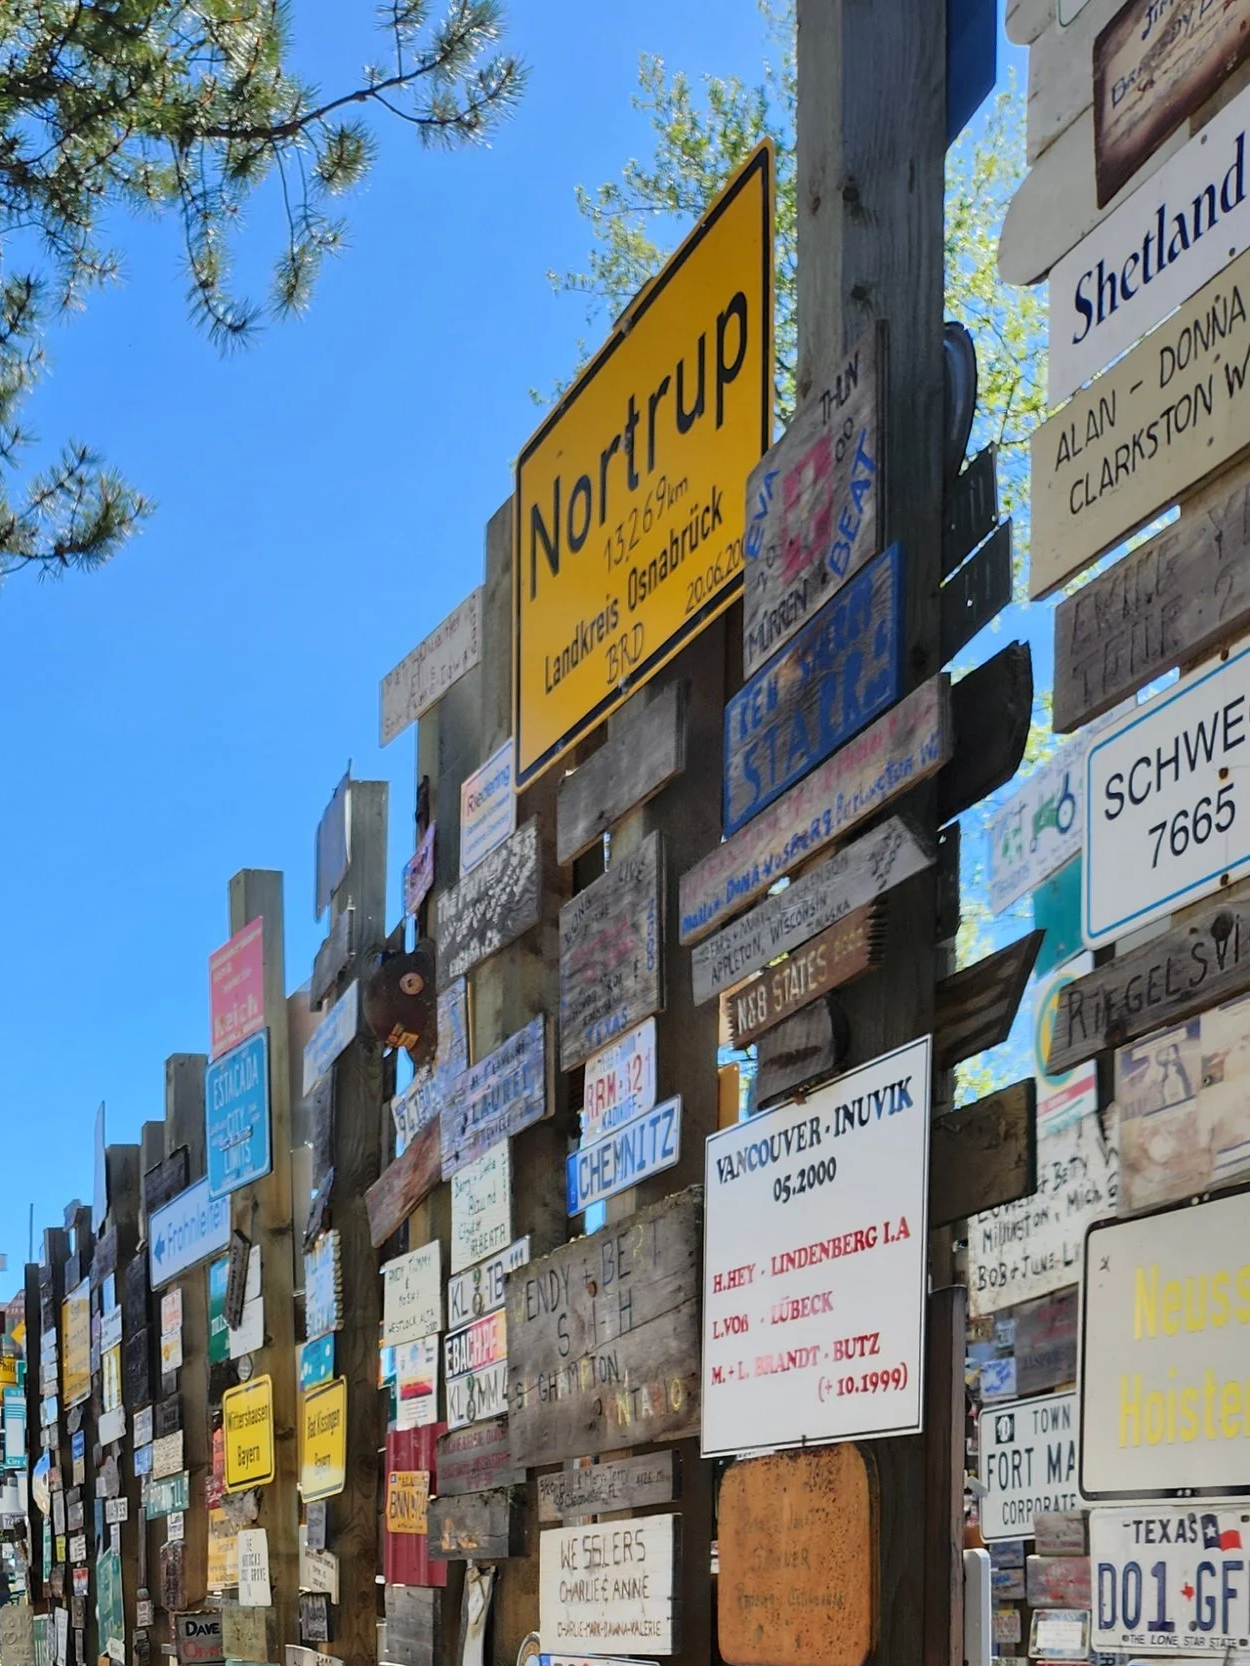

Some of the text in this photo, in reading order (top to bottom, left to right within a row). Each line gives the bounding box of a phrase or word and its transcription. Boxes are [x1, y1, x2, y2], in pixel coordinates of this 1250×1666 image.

[1070, 130, 1246, 345] Shetland
[1053, 285, 1246, 472] ALAN DONNA
[529, 290, 750, 602] Nortrup
[1067, 372, 1214, 516] CLARKSTON
[745, 427, 878, 578] EVA BEAT
[544, 484, 724, 696] Landkreis Osnabrück
[605, 620, 645, 685] BRD
[1148, 783, 1237, 871] 7665
[710, 894, 829, 988] APPLETON, WISCONSIN
[772, 943, 828, 1014] STATES
[213, 1053, 258, 1111] ESTACADA
[225, 1102, 245, 1135] CITY
[716, 1075, 915, 1184] VANCOUVER INUVIK
[579, 1107, 675, 1200] CHEMNITZ
[772, 1155, 837, 1204] 05.2000
[602, 1220, 659, 1287] BERT
[770, 1224, 879, 1277] LINDENBERG
[977, 1262, 1008, 1292] BOB
[451, 1281, 468, 1321] KL
[770, 1290, 835, 1326] LÜBECK
[753, 1332, 881, 1379] BRANDT BUTZ
[835, 1360, 908, 1398] 10.1999)
[1032, 1401, 1071, 1437] TOWN
[237, 1443, 261, 1468] Bayern
[986, 1446, 1035, 1493] FORT
[1132, 1517, 1198, 1545] TEXAS
[559, 1575, 650, 1604] CHARLIE ANNE
[185, 1620, 221, 1637] DAVE
[1130, 1633, 1238, 1649] THE LONE STAR STATE
